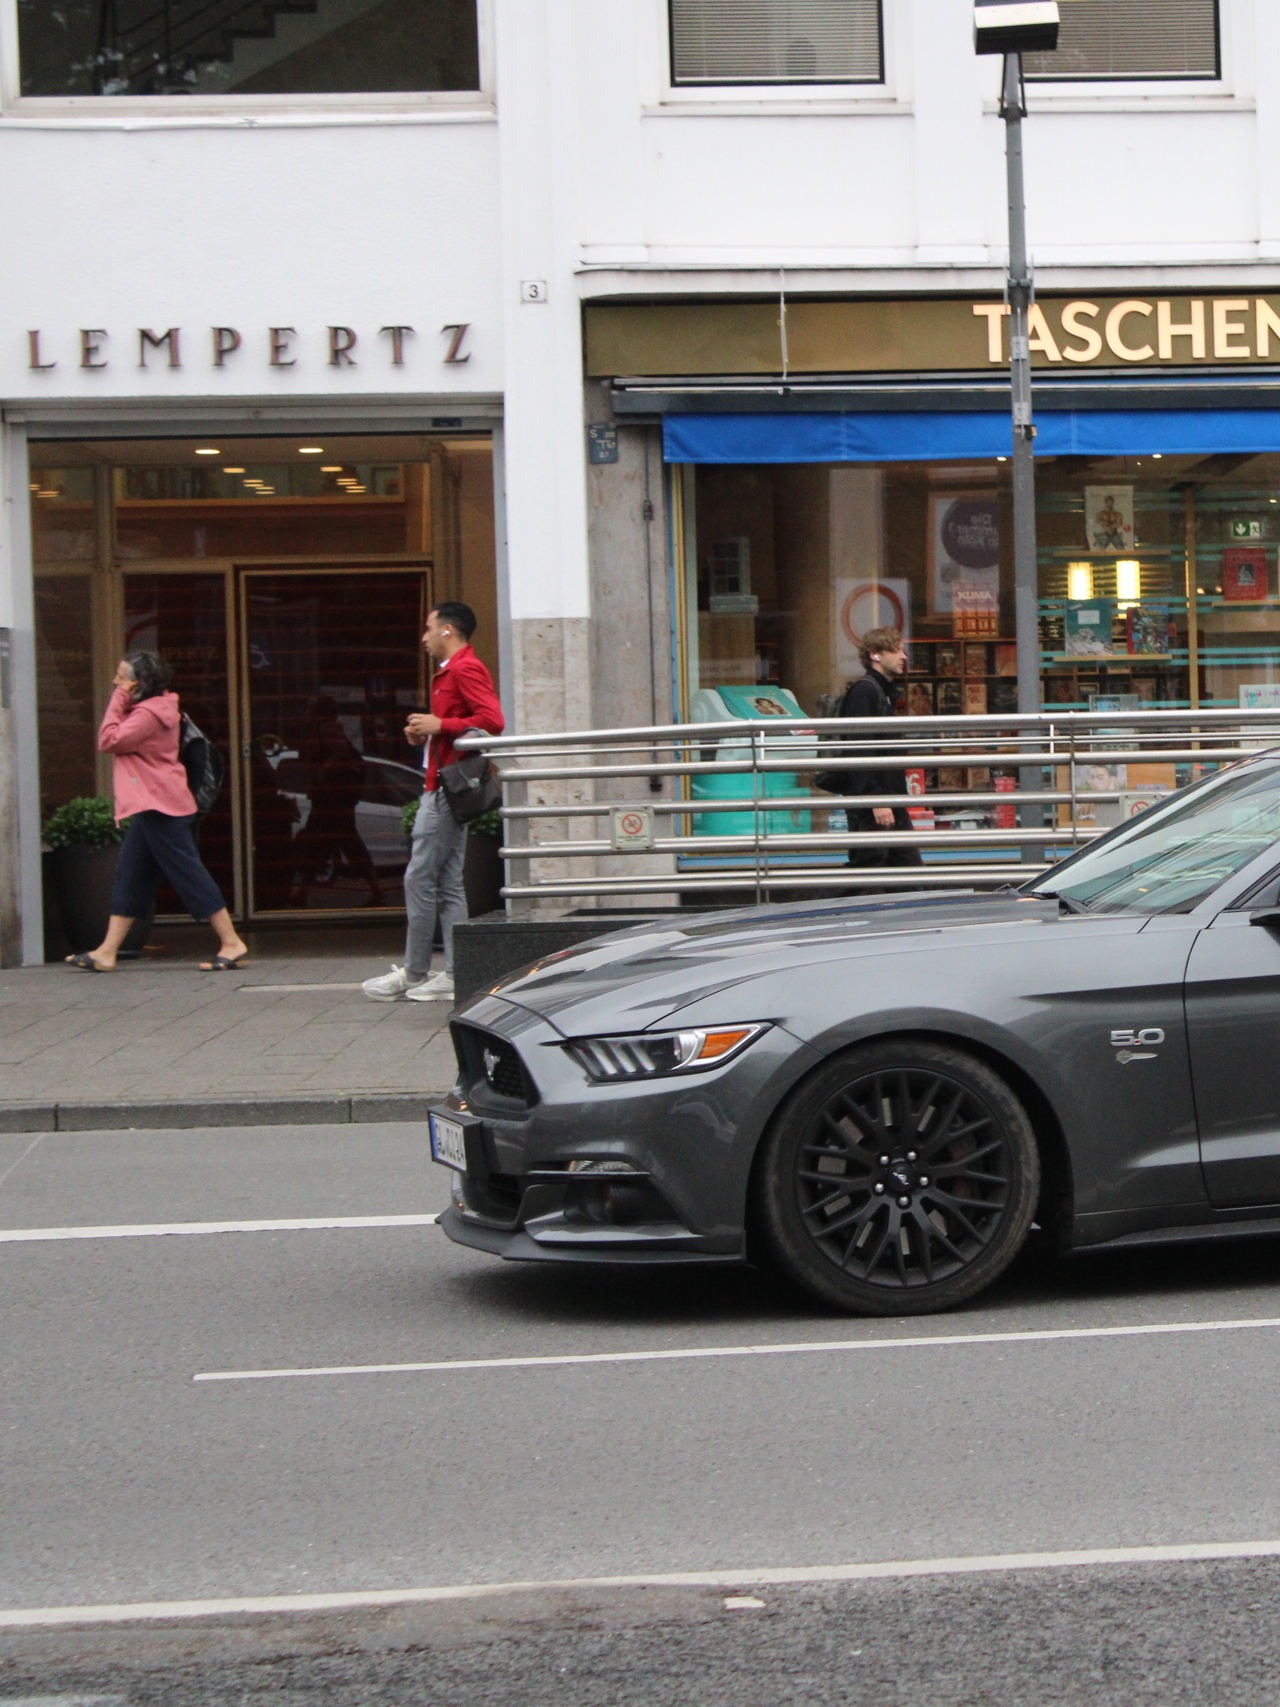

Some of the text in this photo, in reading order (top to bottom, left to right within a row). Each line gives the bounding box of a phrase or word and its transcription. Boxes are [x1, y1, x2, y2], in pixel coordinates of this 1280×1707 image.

[529, 284, 539, 299] 3
[27, 323, 473, 369] LEMPERTZ
[1110, 1027, 1166, 1047] 5.0
